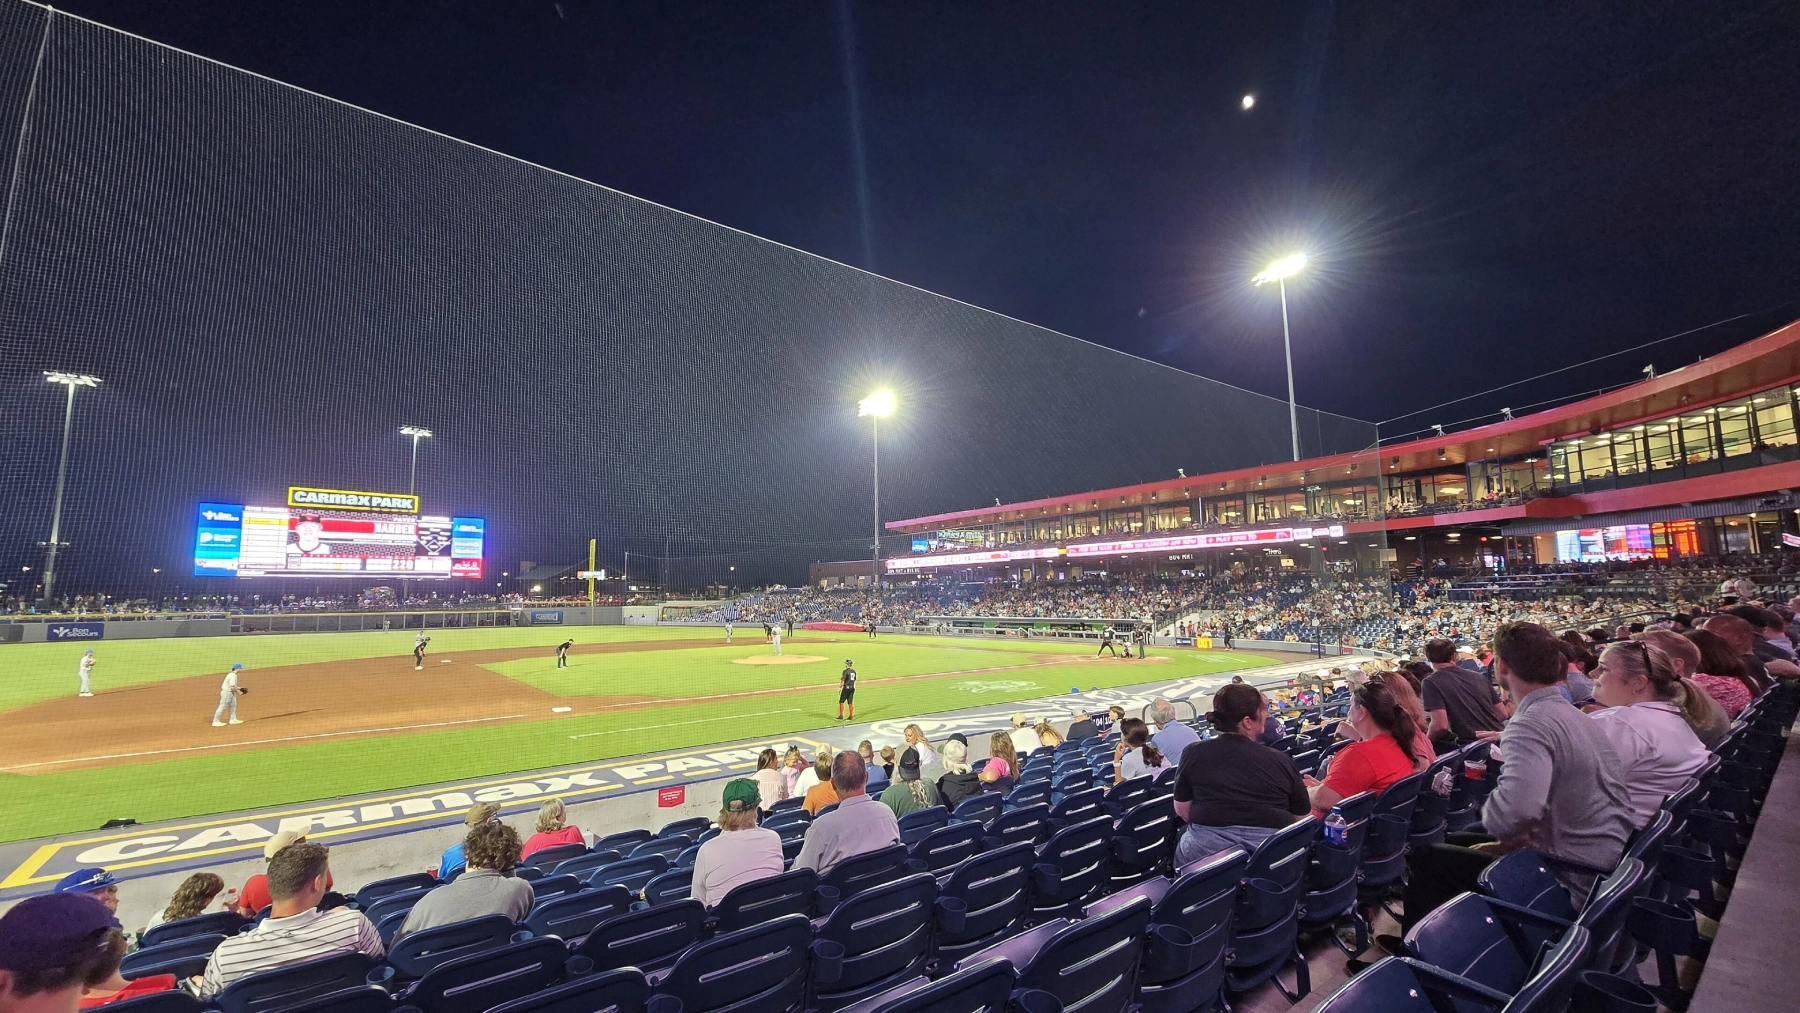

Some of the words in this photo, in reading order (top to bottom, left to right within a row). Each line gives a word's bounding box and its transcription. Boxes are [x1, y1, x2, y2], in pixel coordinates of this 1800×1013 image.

[371, 496, 414, 509] PARK
[374, 522, 415, 534] HARBER
[392, 560, 414, 571] 220
